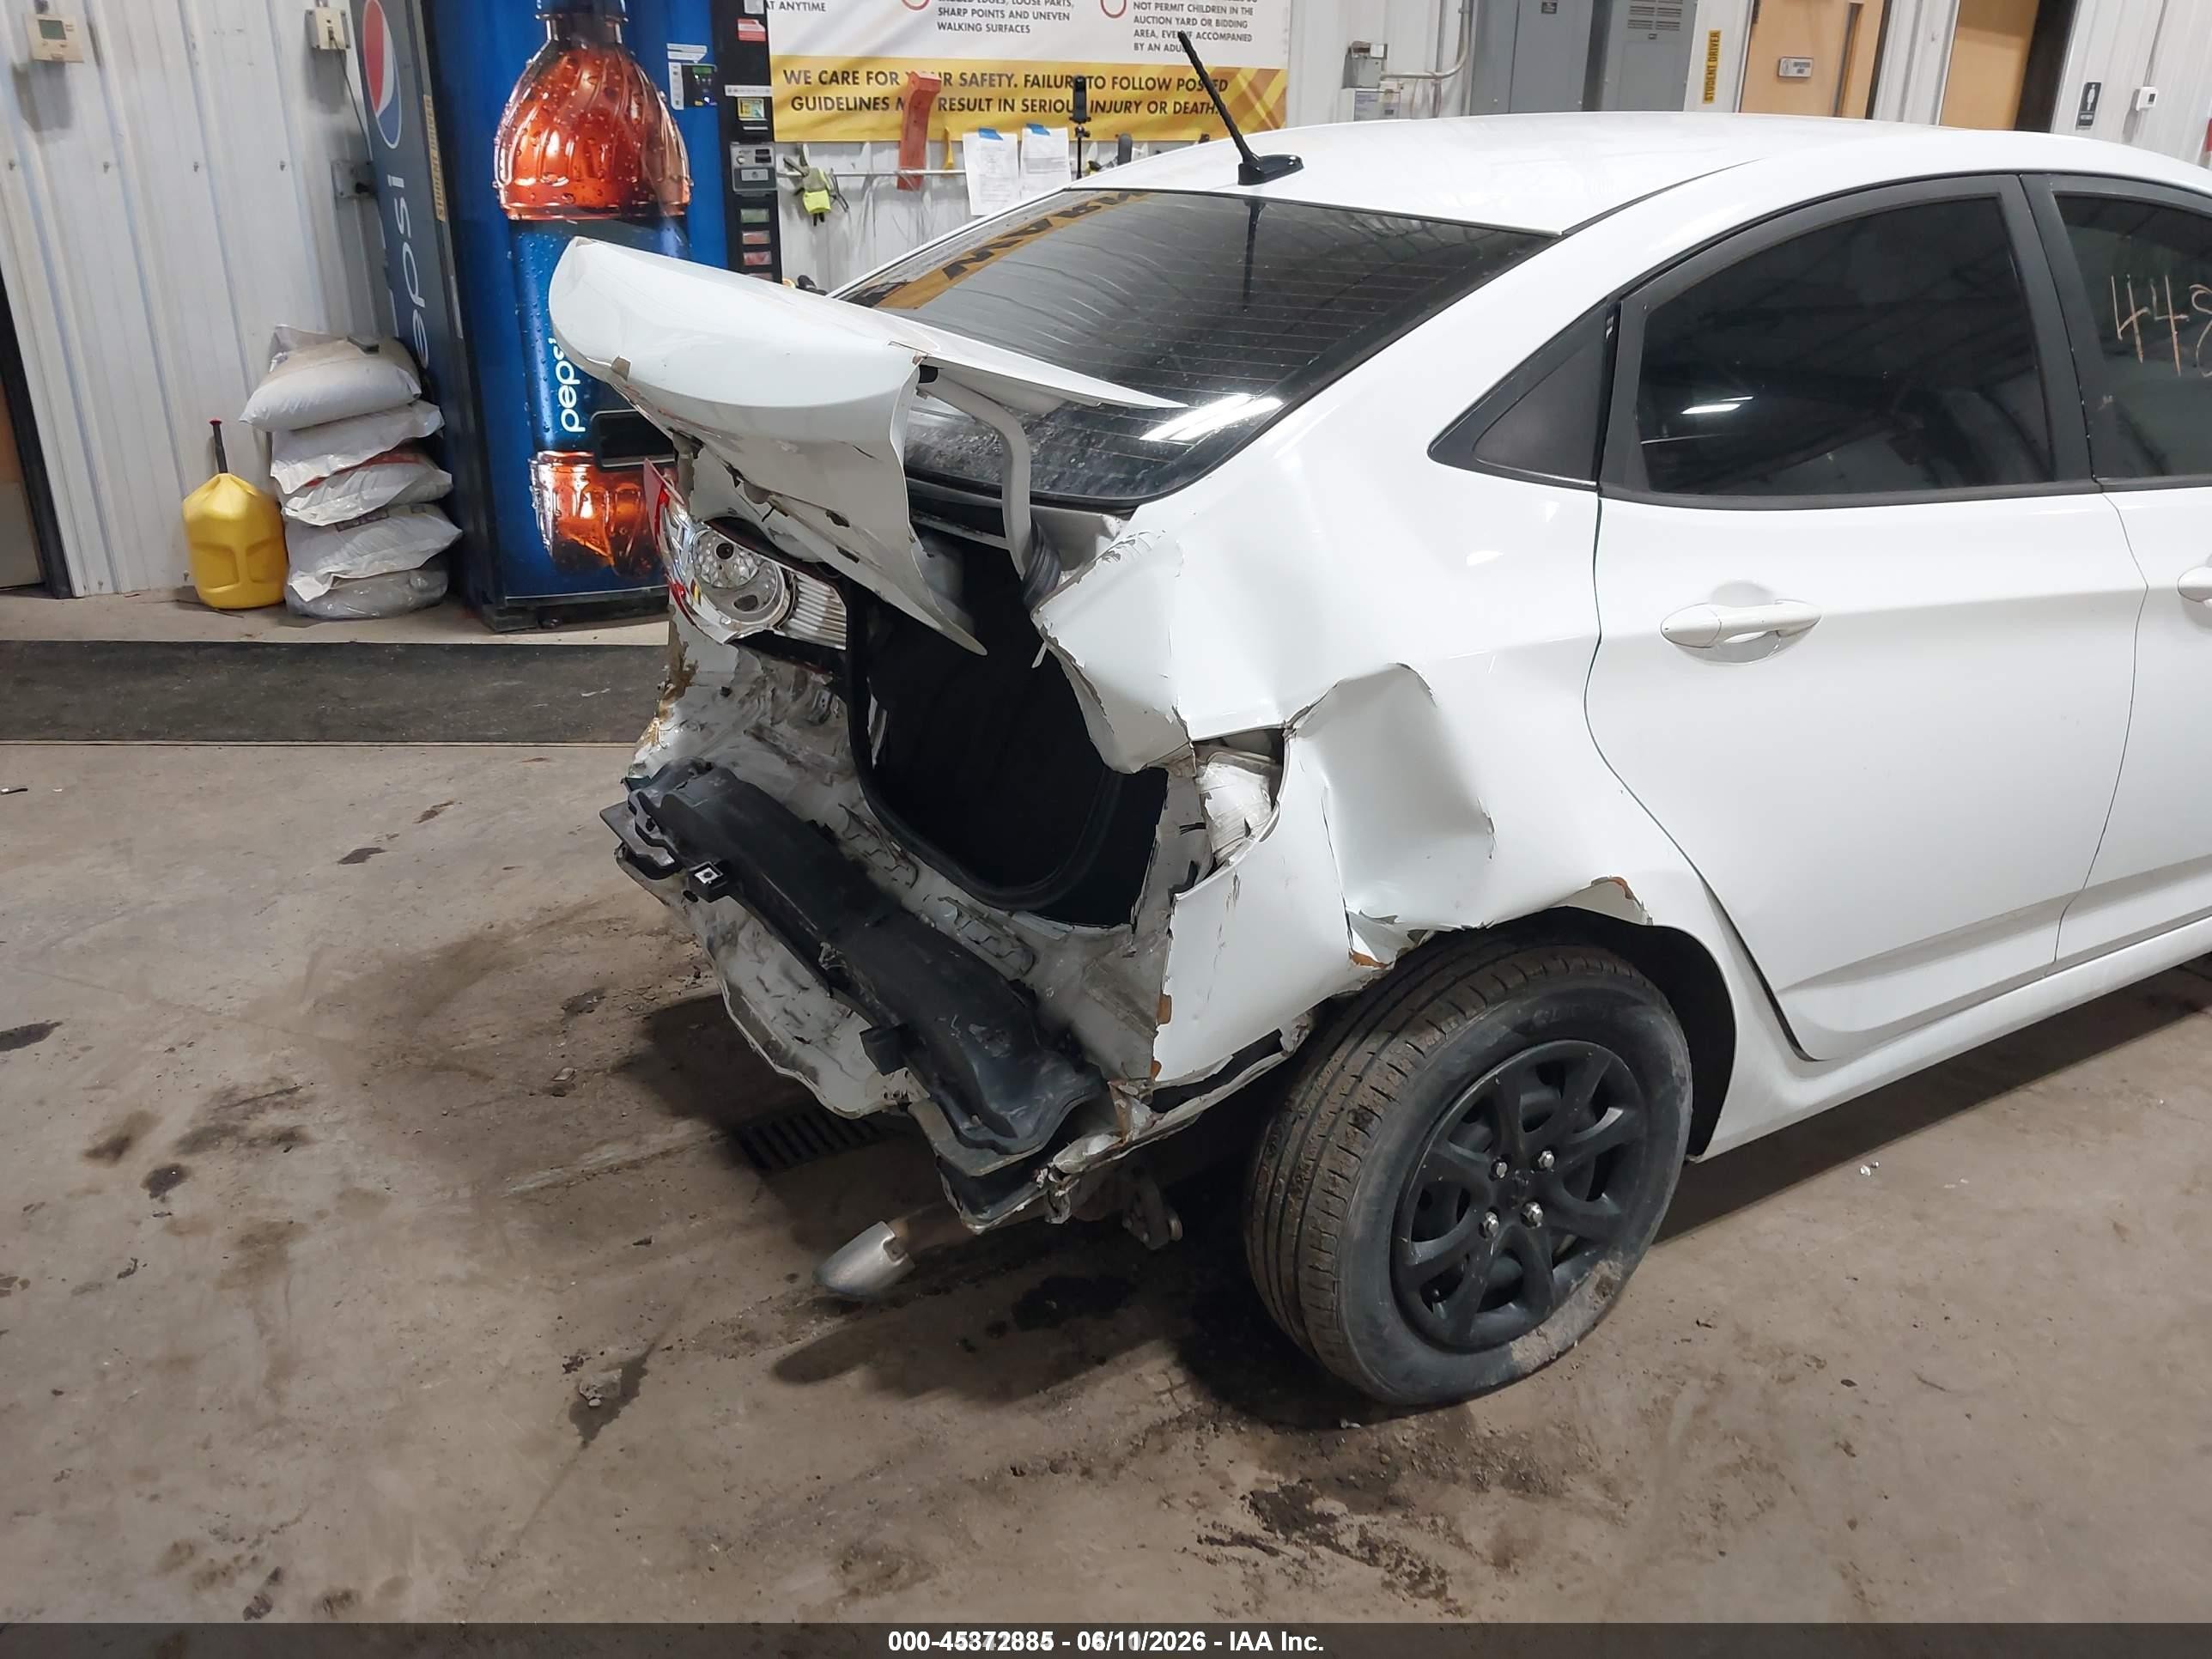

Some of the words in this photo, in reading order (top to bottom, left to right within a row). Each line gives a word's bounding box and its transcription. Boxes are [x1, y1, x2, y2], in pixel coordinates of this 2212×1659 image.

[779, 1, 826, 12] ANYTIME
[1044, 0, 1075, 9] PARTS,
[1133, 2, 1152, 10] NOT
[1154, 3, 1184, 12] PERMIT
[1188, 3, 1226, 14] CHILDREN
[1229, 6, 1238, 15] IN
[1241, 7, 1254, 15] THE
[938, 7, 969, 17] SHARP
[971, 9, 1006, 19] POINTS
[1008, 10, 1030, 19] AND
[1032, 11, 1070, 21] UNEVEN
[937, 21, 982, 32] WALKING
[986, 23, 1030, 33] SURFACES
[1133, 15, 1172, 25] AUCTION
[1175, 17, 1198, 27] YARD
[1200, 18, 1212, 27] OR
[1215, 19, 1248, 28] BIDDING
[1133, 29, 1158, 39] AREA,
[1162, 30, 1179, 40] EVE
[1195, 32, 1252, 42] ACCOMPANIED
[1133, 43, 1145, 52] BY
[1164, 44, 1186, 53] ADU
[783, 70, 811, 85] WE
[818, 70, 860, 86] CARE
[866, 70, 901, 86] FOR
[959, 72, 1018, 88] SAFETY.
[1024, 74, 1073, 89] FAILUR
[1085, 76, 1106, 90] TO
[1112, 76, 1172, 92] FOLLOW
[791, 96, 890, 112] GUIDELINES
[938, 97, 991, 112] RESULT
[998, 98, 1015, 112] IN
[1021, 98, 1073, 113] SERIOU
[1091, 100, 1142, 114] INJURY
[1147, 100, 1169, 114] OR
[1173, 100, 1219, 115] DEATH.
[387, 174, 428, 369] epsi
